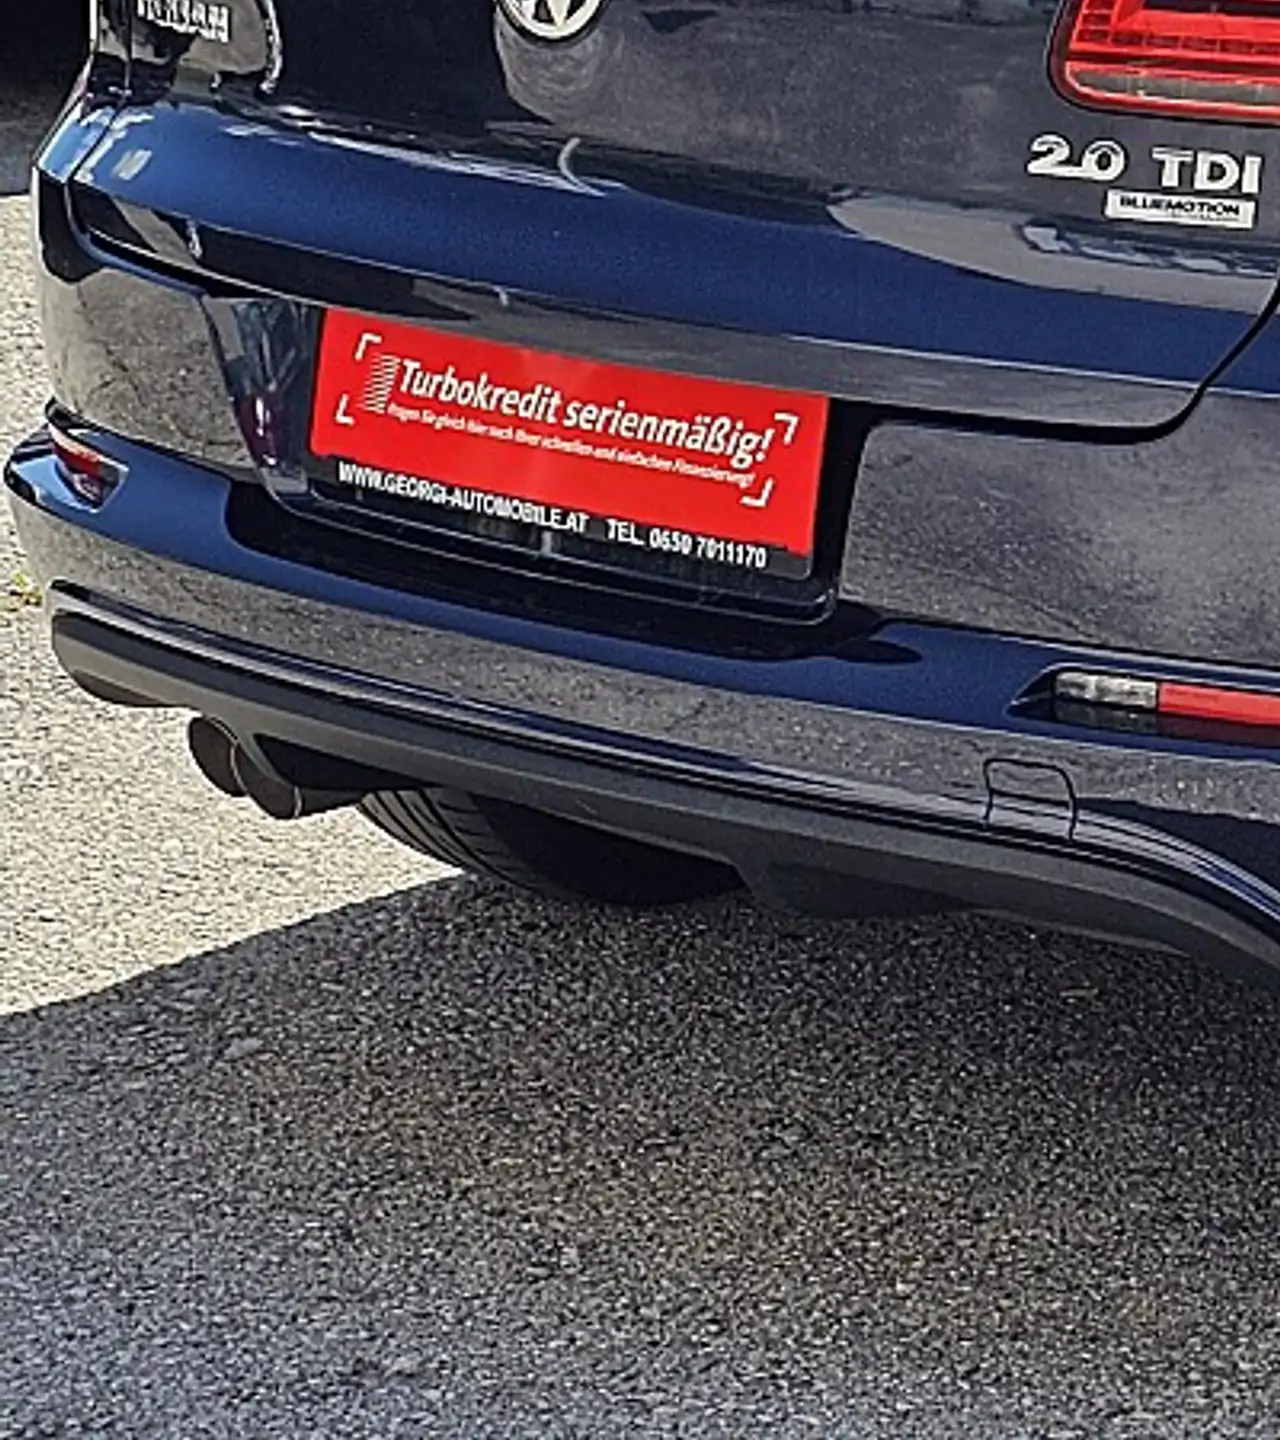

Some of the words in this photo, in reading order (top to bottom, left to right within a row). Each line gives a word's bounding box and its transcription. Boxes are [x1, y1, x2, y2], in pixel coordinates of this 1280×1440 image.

[1119, 194, 1241, 217] BLUEMOTION
[1152, 146, 1262, 194] TDI
[400, 358, 562, 425] Turbokredit
[563, 400, 775, 471] serienmäßig!
[338, 460, 590, 534] WWW.GEORGI-AUTOMOBILE.AT
[606, 518, 645, 547] TEL.
[649, 527, 692, 556] 0650
[696, 536, 767, 569] 7011170
